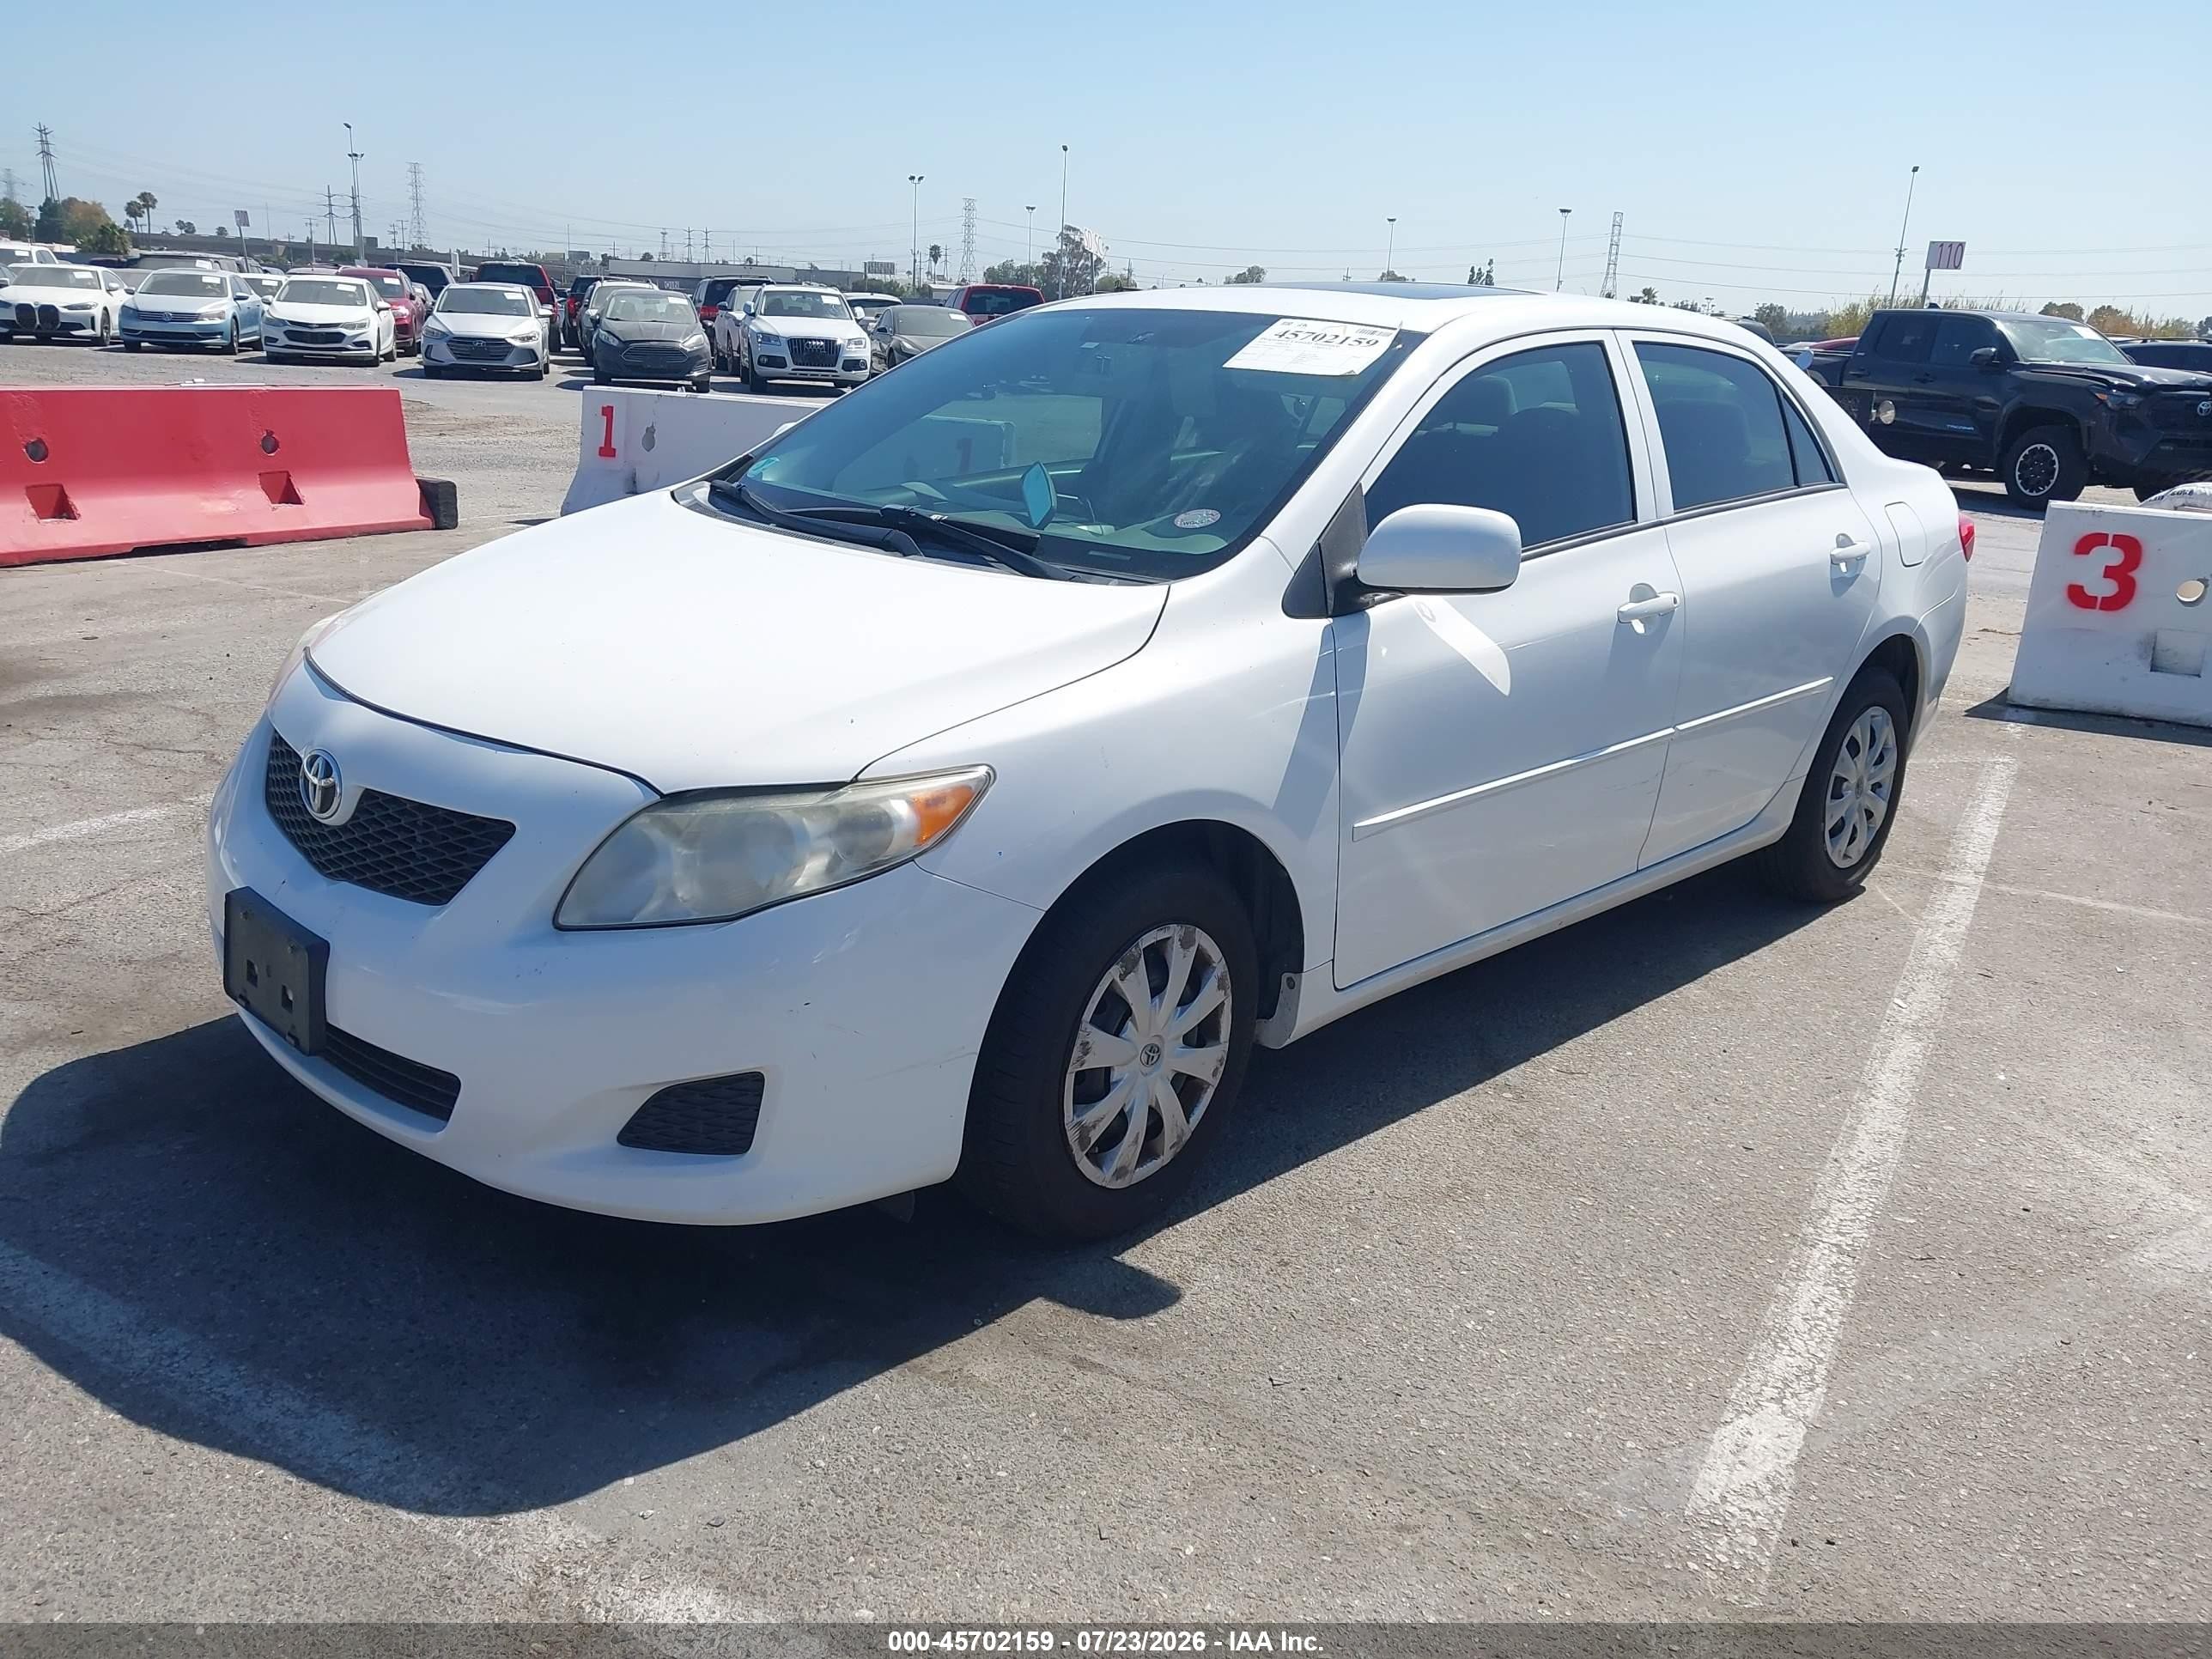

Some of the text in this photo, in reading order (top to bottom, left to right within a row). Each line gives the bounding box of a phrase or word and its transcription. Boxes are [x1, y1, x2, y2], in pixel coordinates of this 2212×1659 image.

[1936, 243, 1964, 269] 110
[1274, 329, 1379, 348] 45702159
[599, 405, 617, 458] 1
[2067, 532, 2142, 611] 3
